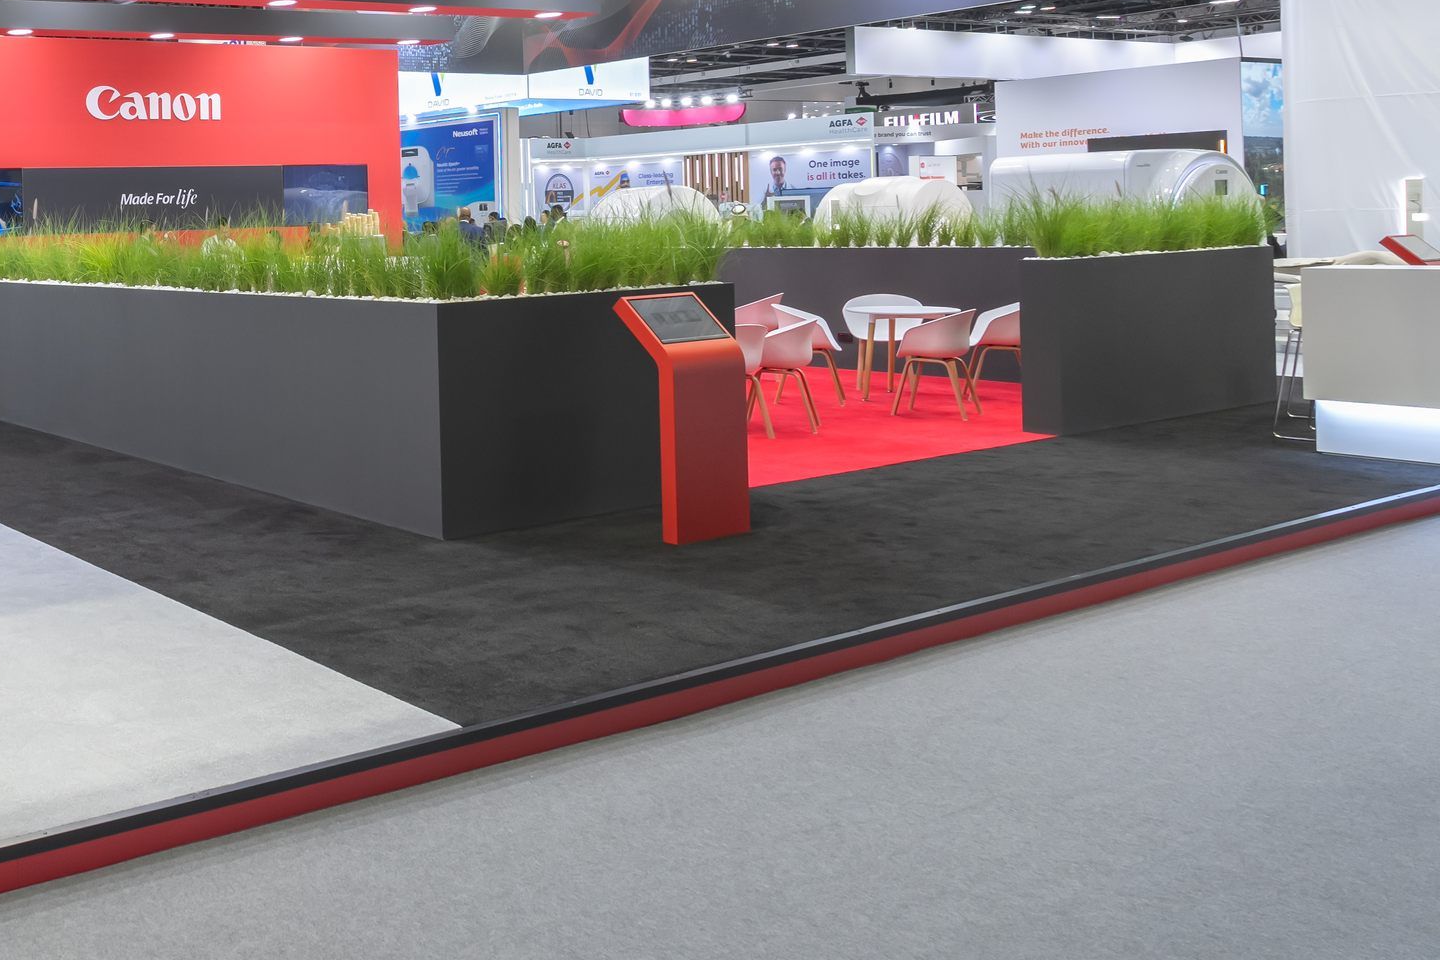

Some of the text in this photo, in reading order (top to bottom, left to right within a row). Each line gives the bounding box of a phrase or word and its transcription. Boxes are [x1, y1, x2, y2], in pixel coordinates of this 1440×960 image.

[578, 88, 603, 97] DAVID
[86, 85, 222, 122] Canon
[427, 98, 450, 109] DAVID
[829, 119, 853, 128] AGFA
[452, 128, 478, 138] Neusoft
[829, 127, 868, 135] HealthCare
[1021, 131, 1044, 140] Make
[1045, 130, 1063, 139] the
[1063, 126, 1110, 138] difference.
[1021, 139, 1041, 149] With
[1042, 139, 1057, 148] our
[808, 157, 860, 168] One image
[807, 169, 866, 181] is all it takes.
[120, 189, 198, 209] Made For life
